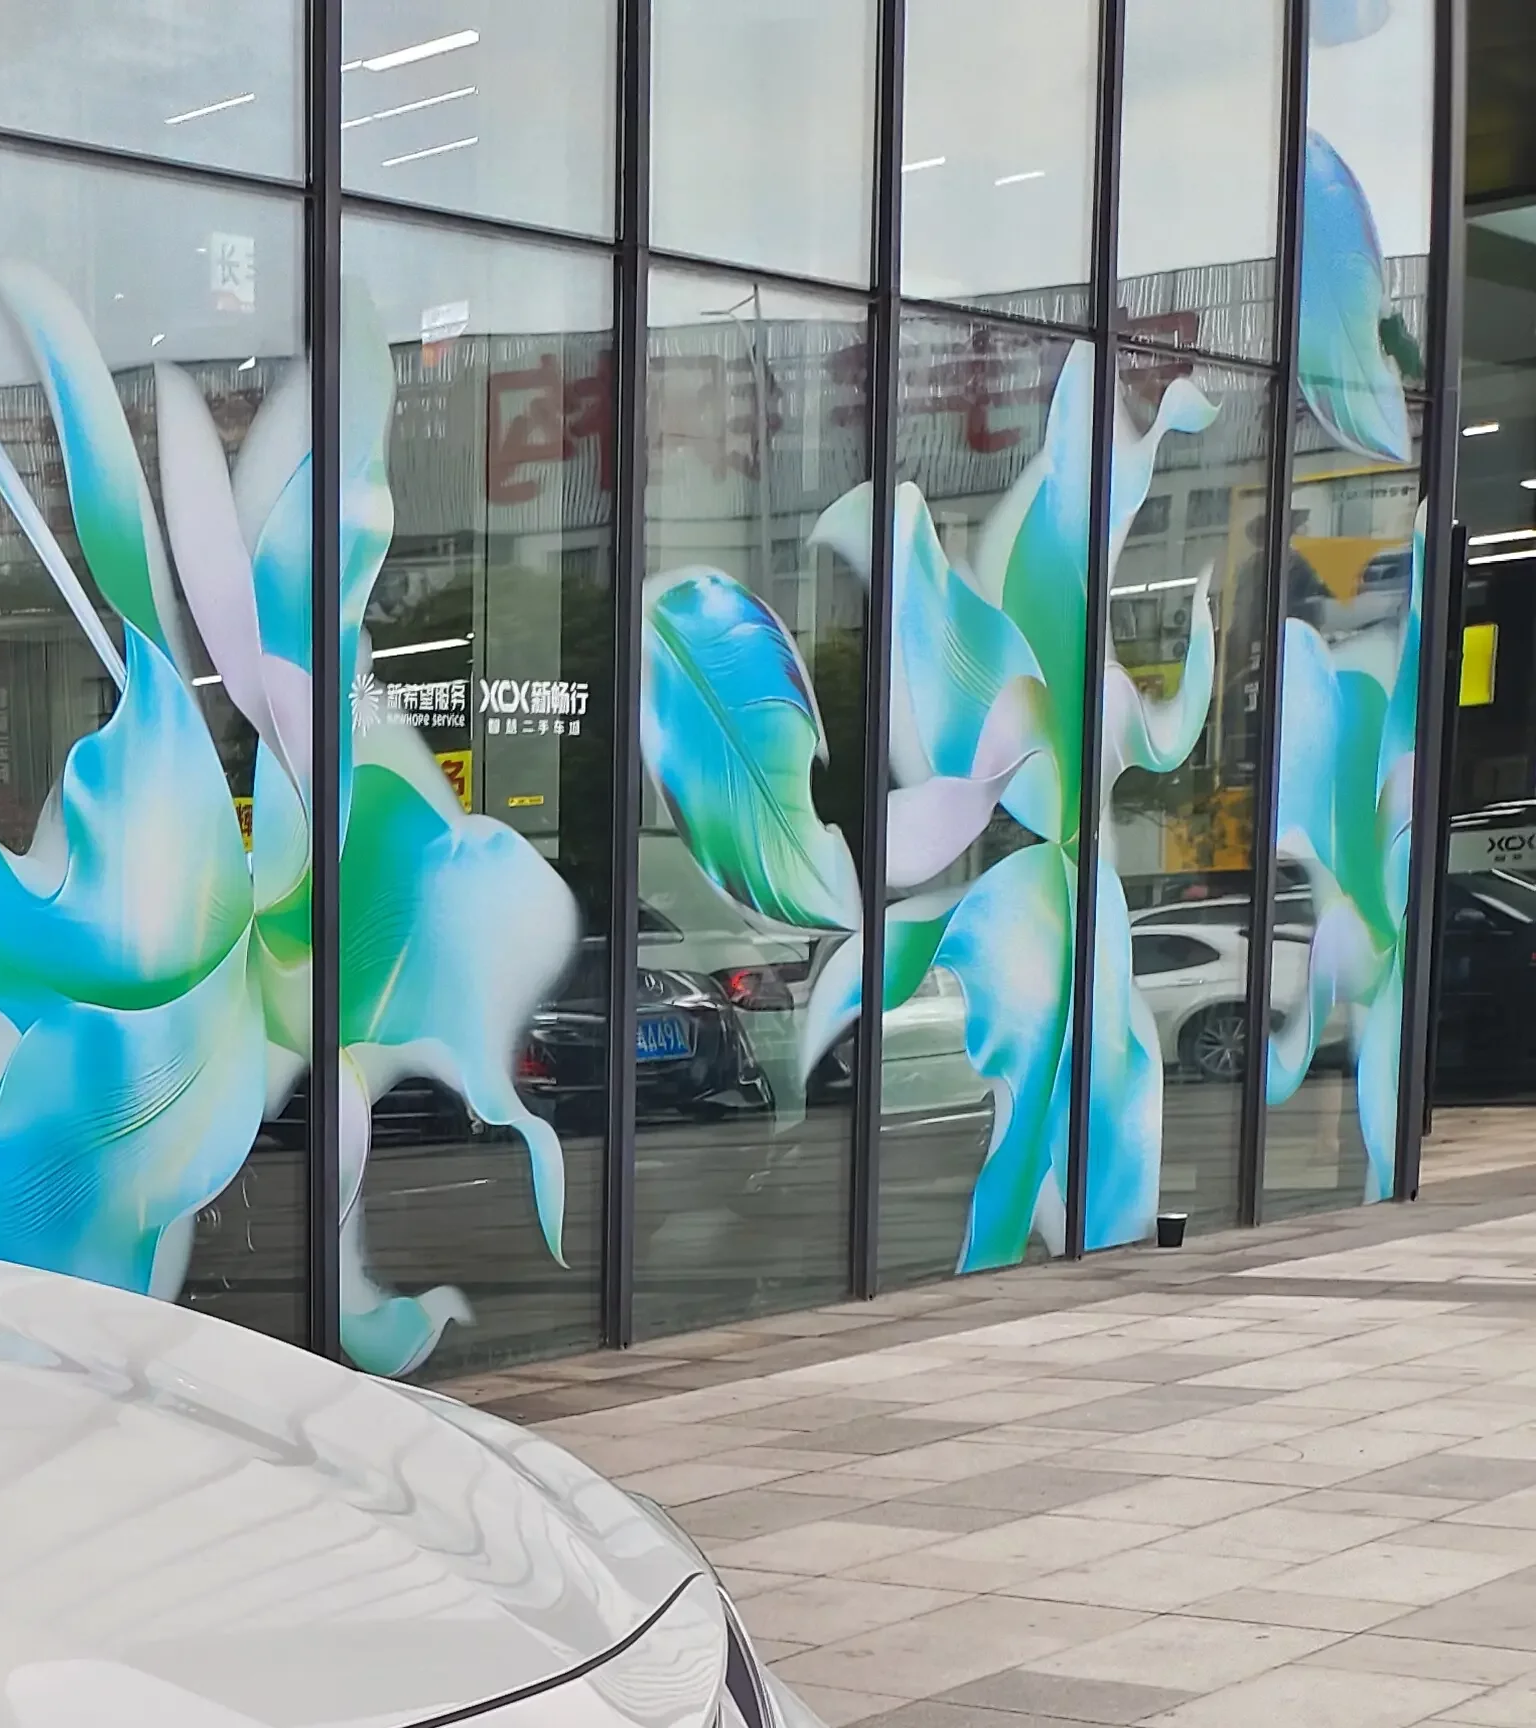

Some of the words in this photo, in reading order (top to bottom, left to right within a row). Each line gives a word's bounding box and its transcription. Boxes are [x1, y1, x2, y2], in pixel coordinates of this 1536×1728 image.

[387, 680, 466, 711] 新希望服务
